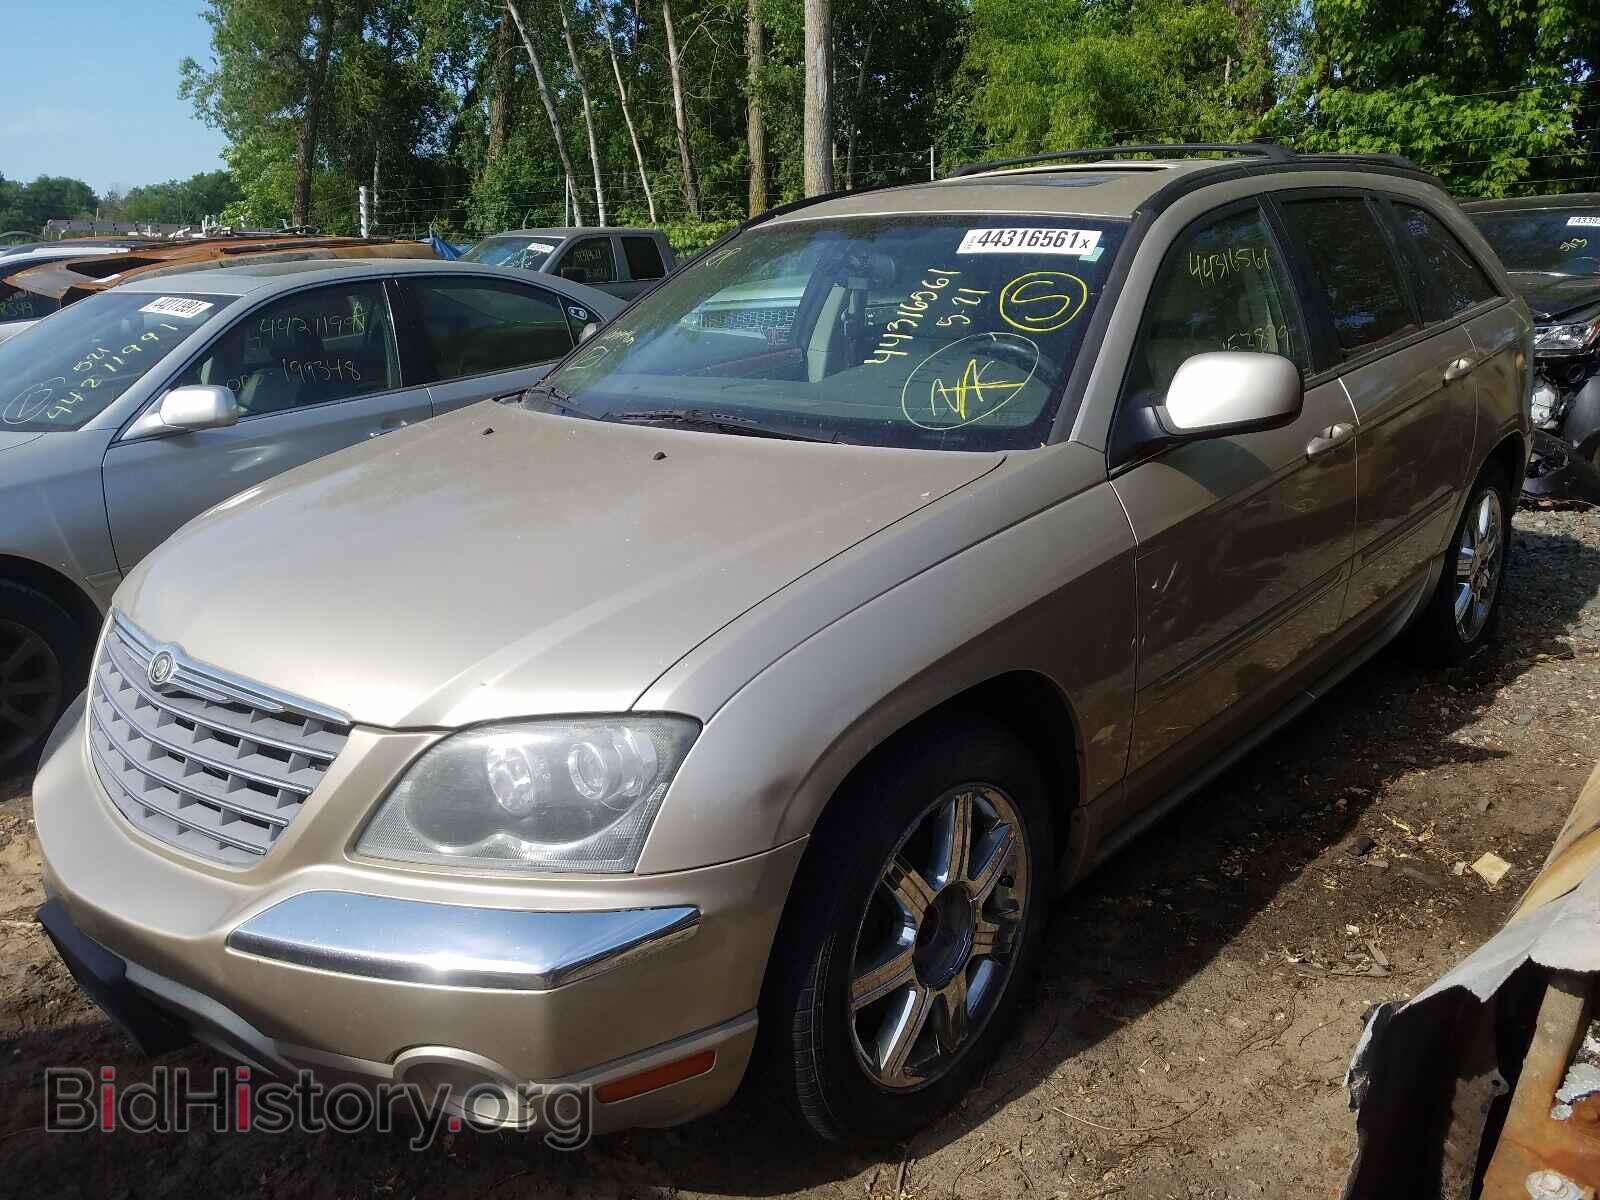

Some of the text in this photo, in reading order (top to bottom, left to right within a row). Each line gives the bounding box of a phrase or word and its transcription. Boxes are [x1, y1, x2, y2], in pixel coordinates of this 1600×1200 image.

[977, 229, 1081, 249] 44316561
[862, 267, 962, 364] 44316561
[47, 322, 179, 420] 44211991
